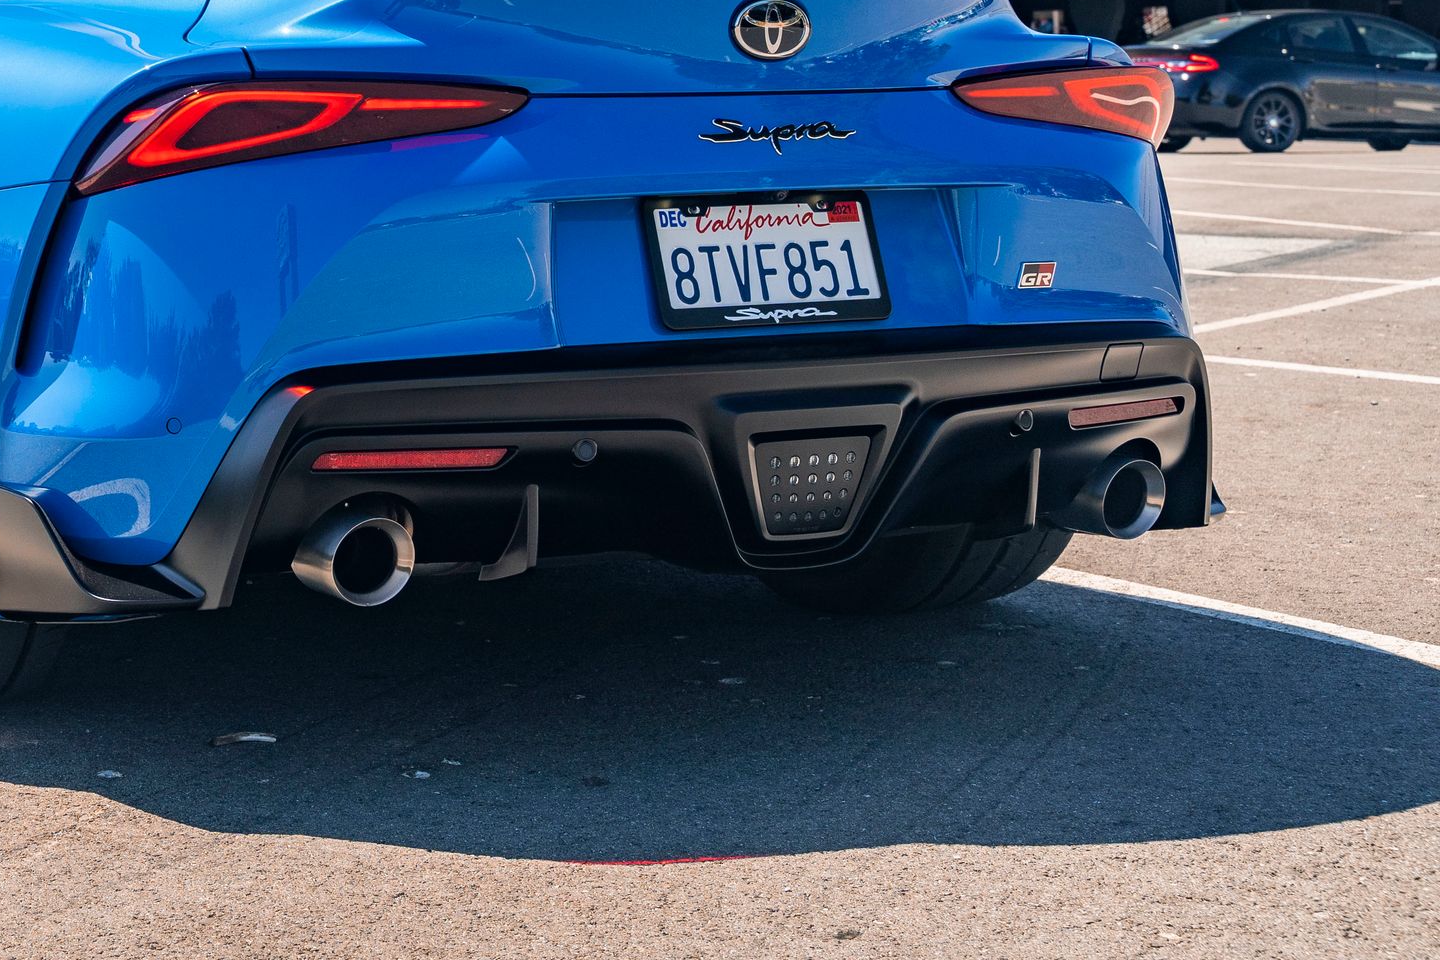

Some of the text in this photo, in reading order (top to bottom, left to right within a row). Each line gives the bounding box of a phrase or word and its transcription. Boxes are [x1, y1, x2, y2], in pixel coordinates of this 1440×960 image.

[698, 118, 857, 155] Supra
[659, 210, 687, 228] DEC
[696, 204, 830, 240] California
[670, 240, 870, 305] 8TVF851
[1021, 272, 1052, 286] GR
[724, 307, 837, 323] Supra
